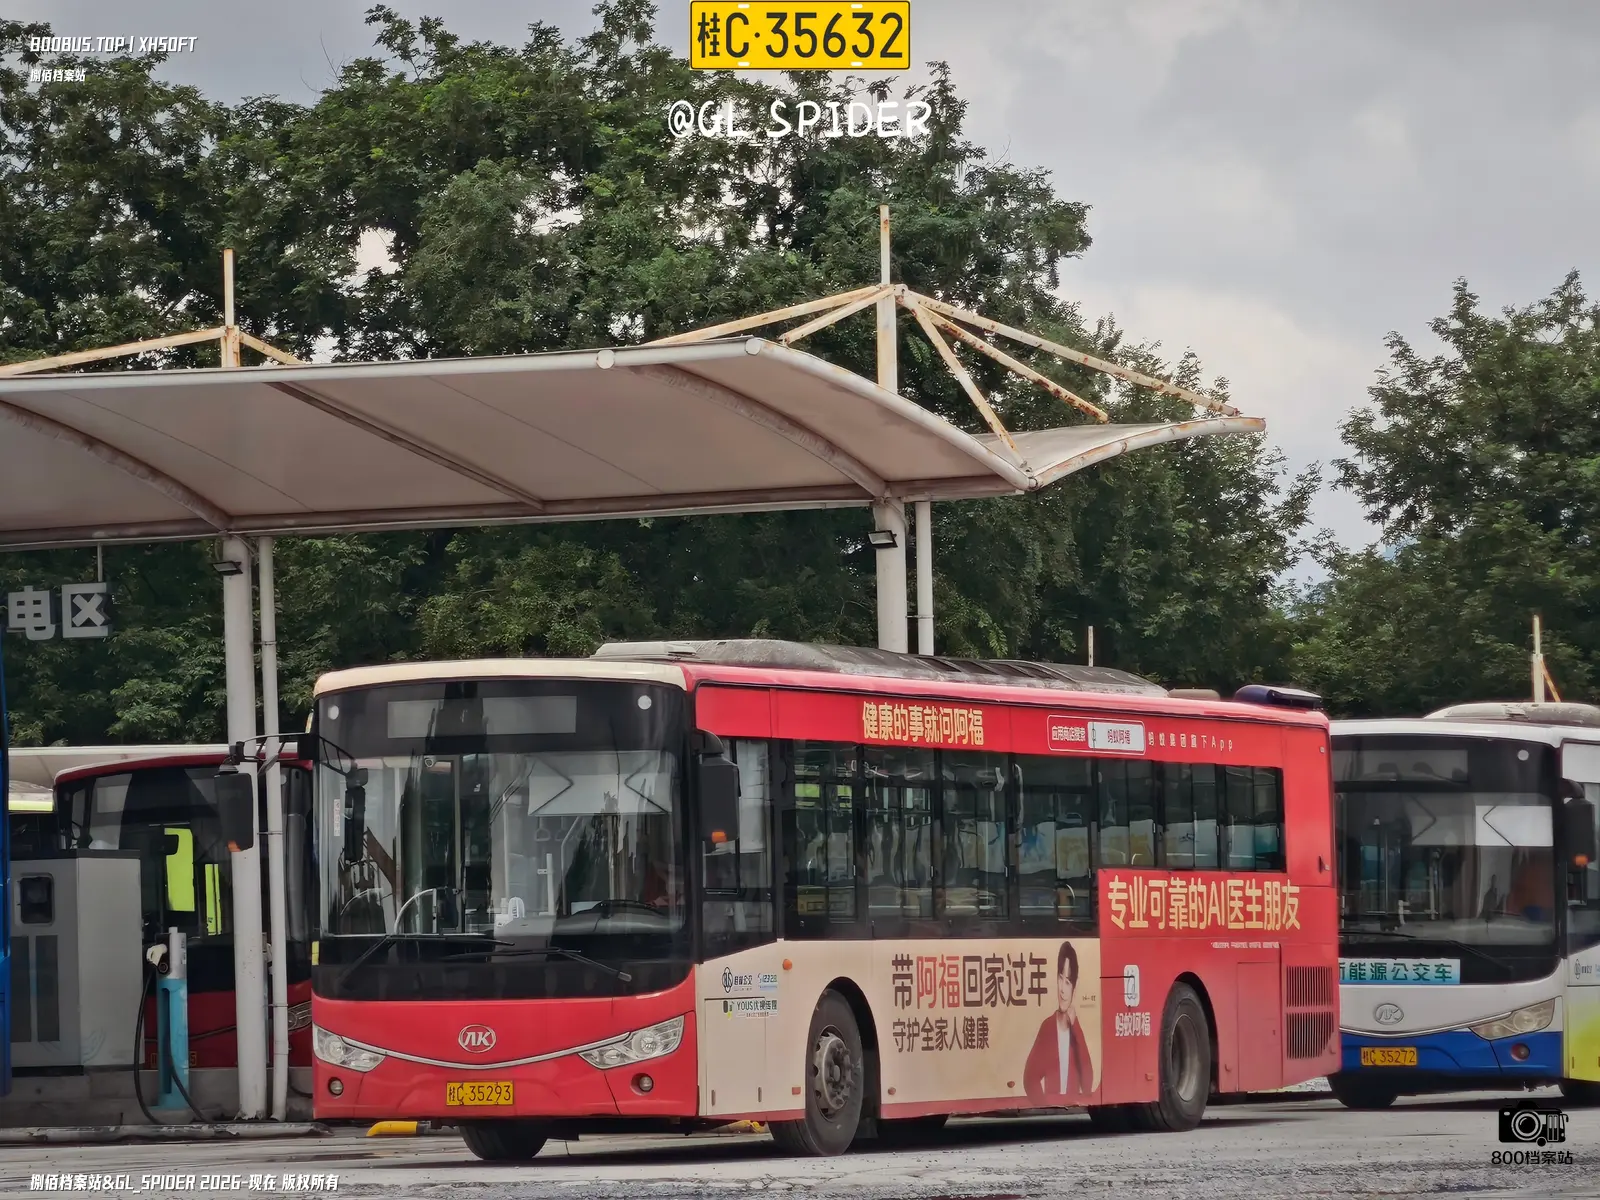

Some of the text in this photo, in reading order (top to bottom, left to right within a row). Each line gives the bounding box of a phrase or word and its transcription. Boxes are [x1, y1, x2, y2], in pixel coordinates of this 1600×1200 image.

[8, 582, 108, 640] 电区
[862, 701, 985, 746] 健康的事就问阿福
[1107, 875, 1301, 930] 专业可靠的AI医生朋友
[891, 952, 1048, 1010] 带阿福回家过年
[892, 1016, 990, 1053] 守护全家人健康
[1115, 1012, 1151, 1037] 蚂蚁阿福
